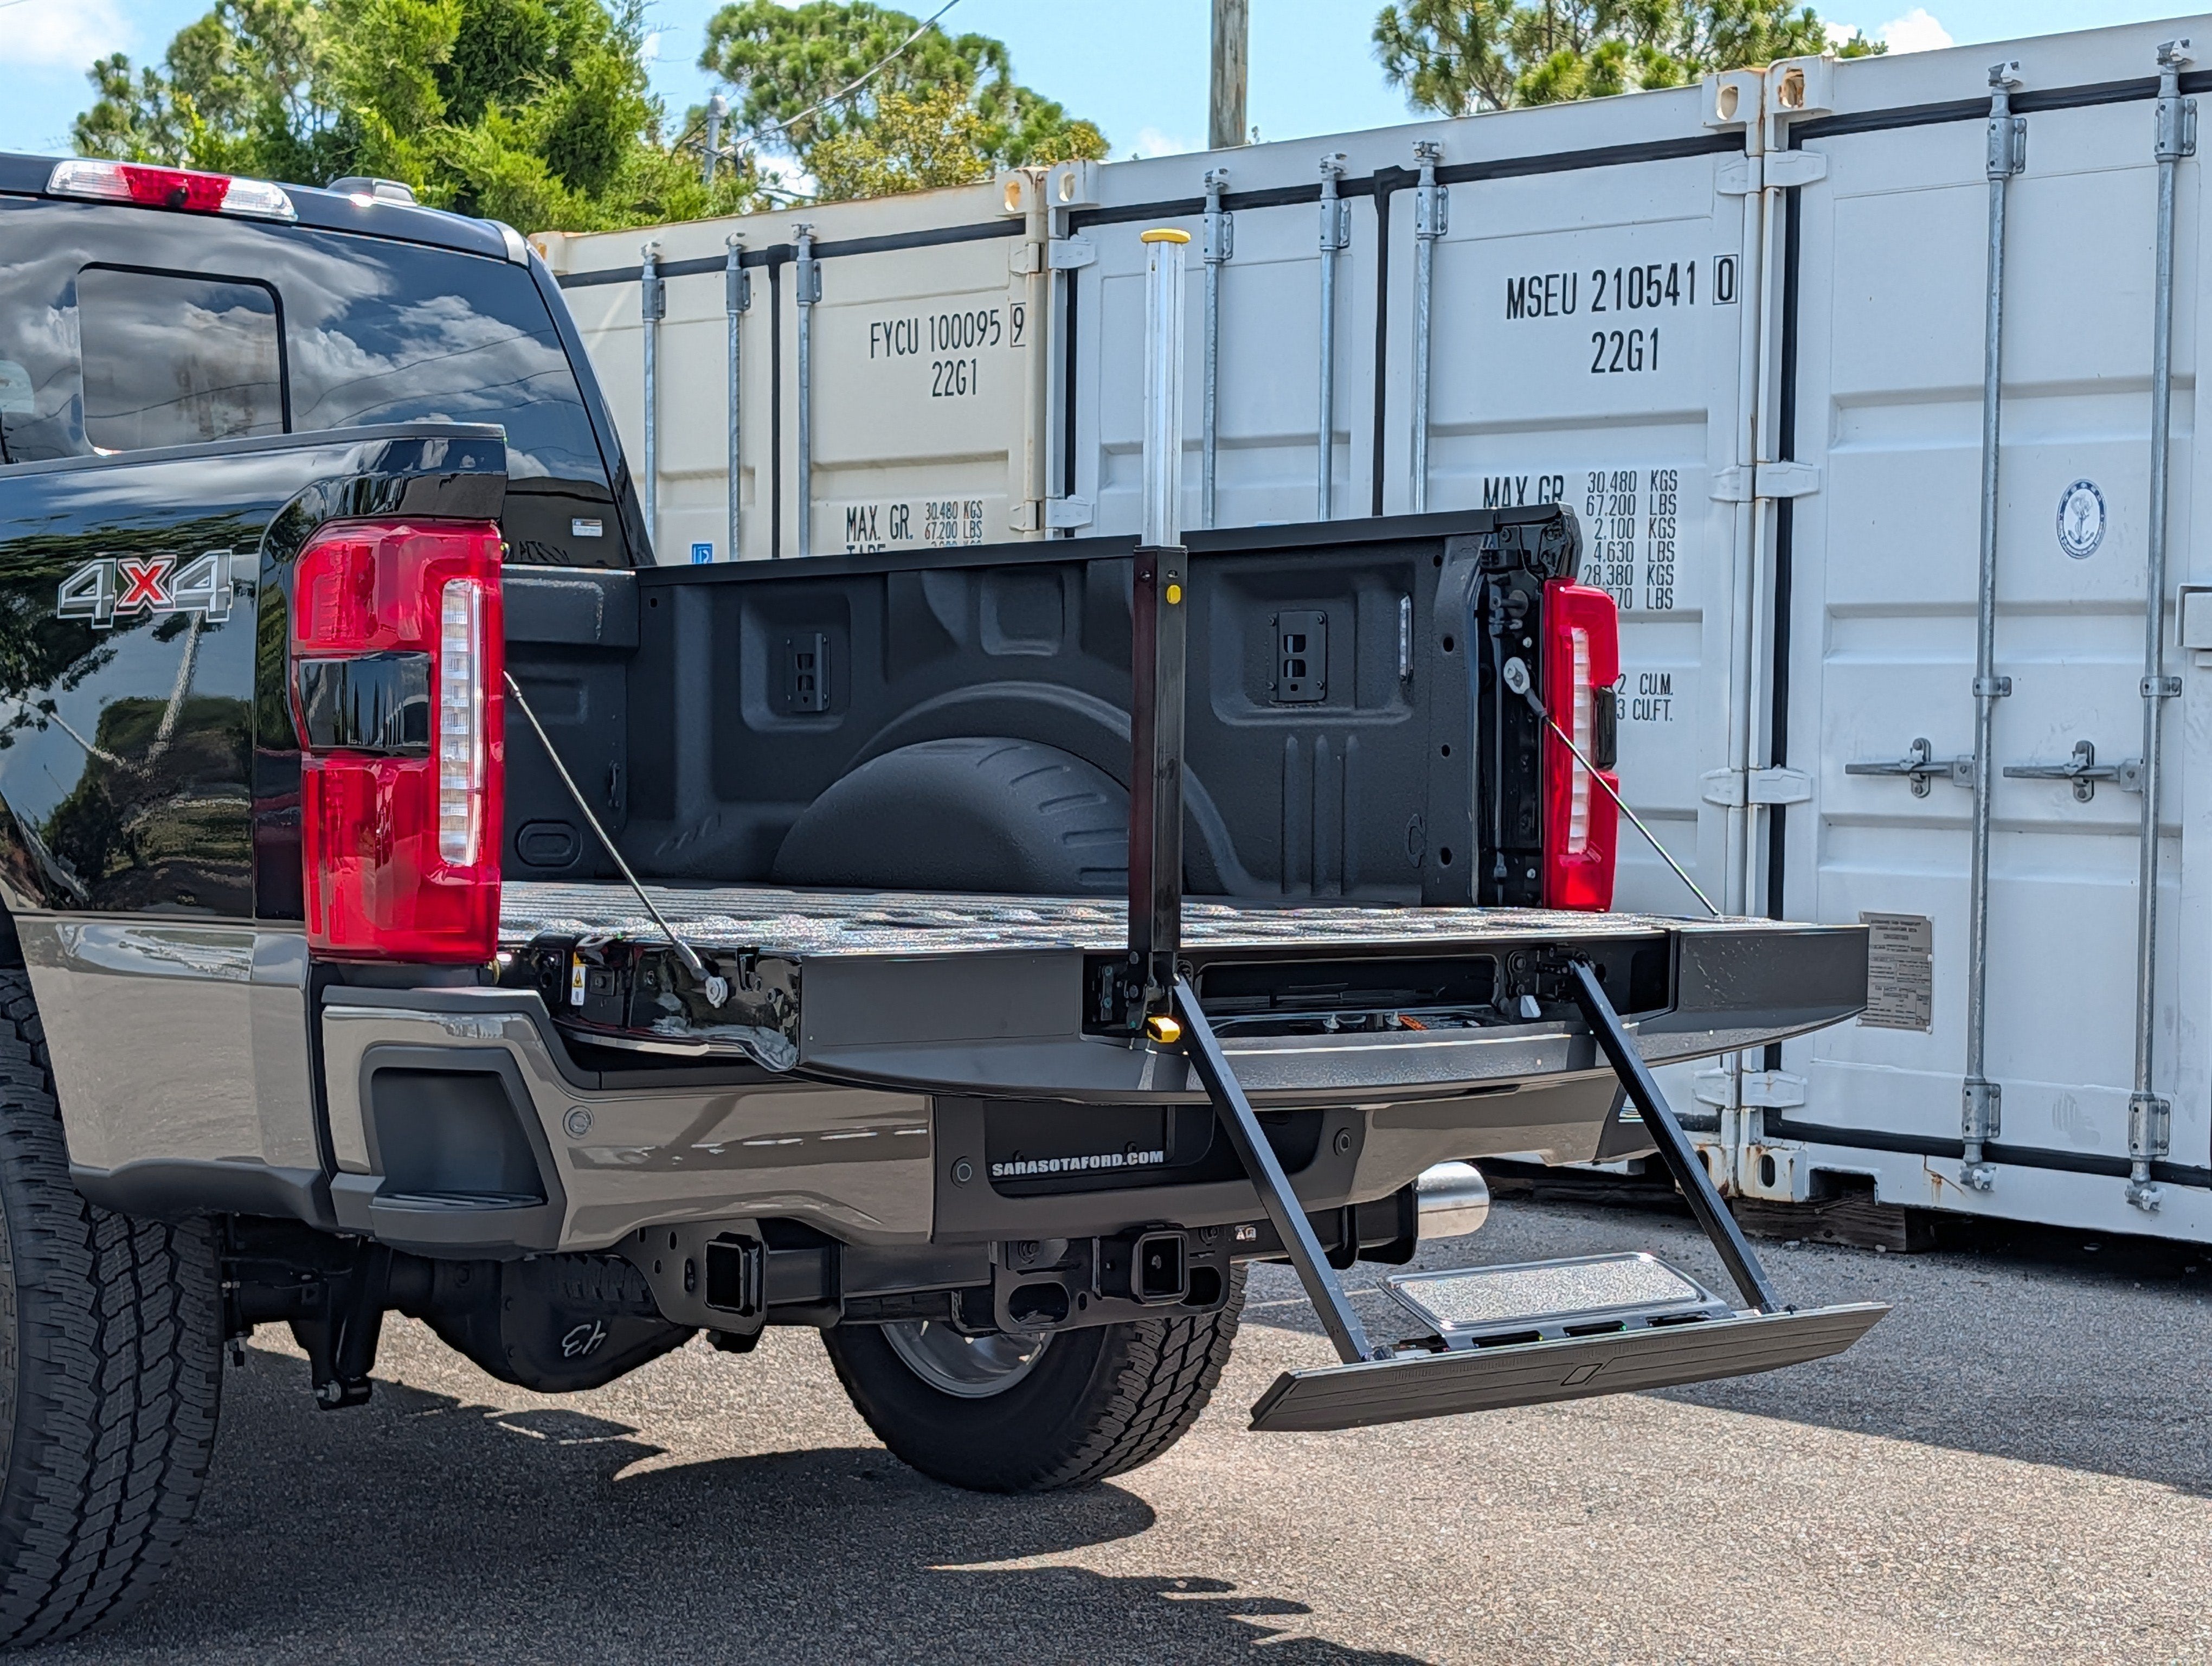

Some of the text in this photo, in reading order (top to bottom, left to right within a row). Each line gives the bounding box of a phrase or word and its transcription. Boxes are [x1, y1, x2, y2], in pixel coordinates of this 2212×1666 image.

[1506, 257, 1734, 319] MSEU 210541 0
[871, 306, 1025, 358] FYCU 100095 9
[1591, 327, 1658, 373] 22G1
[931, 358, 976, 397] 22G1
[1483, 476, 1528, 508] MAX
[1587, 470, 1637, 494] 30.480
[1650, 469, 1677, 492] KGS
[925, 501, 959, 521] 30.480
[963, 500, 983, 520] KGS
[1586, 494, 1677, 516] 67.200 LBS
[924, 520, 983, 540] 67.200 LBS
[1594, 516, 1676, 540] 2.100 KGS
[1593, 540, 1675, 563] 4.630 LBS
[1584, 563, 1674, 586] 28.380 KGS
[1646, 587, 1673, 610] LBS
[992, 1150, 1163, 1177] SARASOTAFORD.COM
